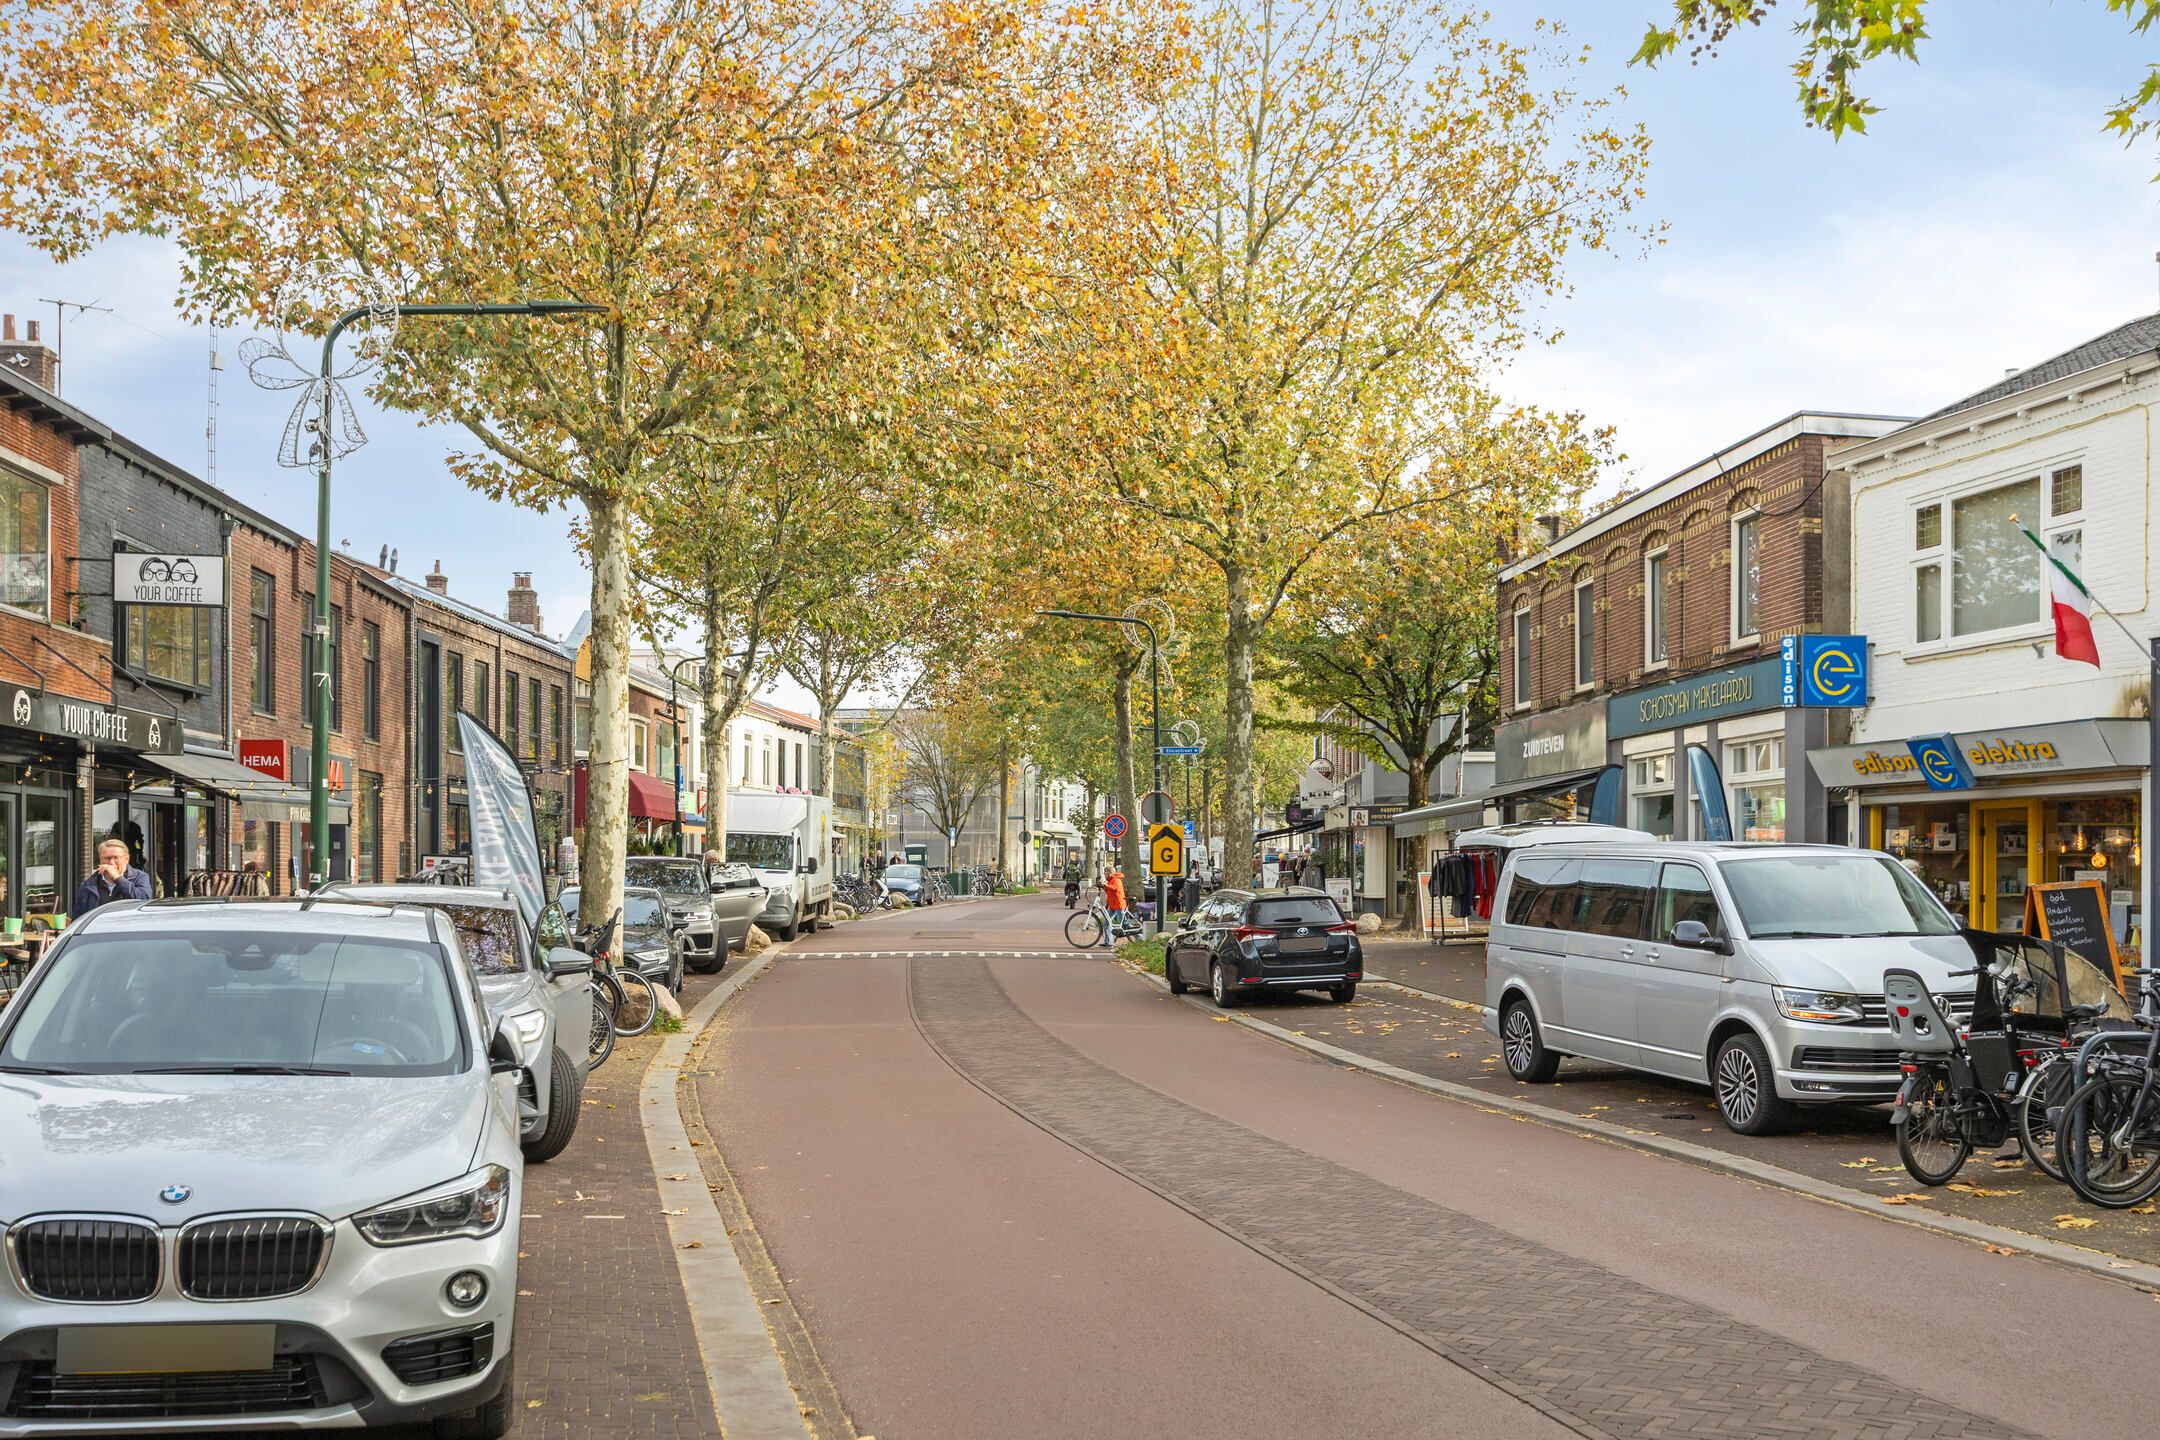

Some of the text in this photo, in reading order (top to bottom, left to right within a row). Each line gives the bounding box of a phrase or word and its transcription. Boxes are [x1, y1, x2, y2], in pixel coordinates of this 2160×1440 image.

[134, 585, 203, 603] YOUR COFFEE
[1782, 638, 1794, 704] edison
[1640, 689, 1691, 723] SCHOTSMAN
[63, 703, 128, 743] YOUR COFFEE
[243, 755, 281, 767] HEMA
[1852, 750, 1919, 776] edison
[1967, 738, 2059, 766] elektra
[1160, 847, 1174, 863] G
